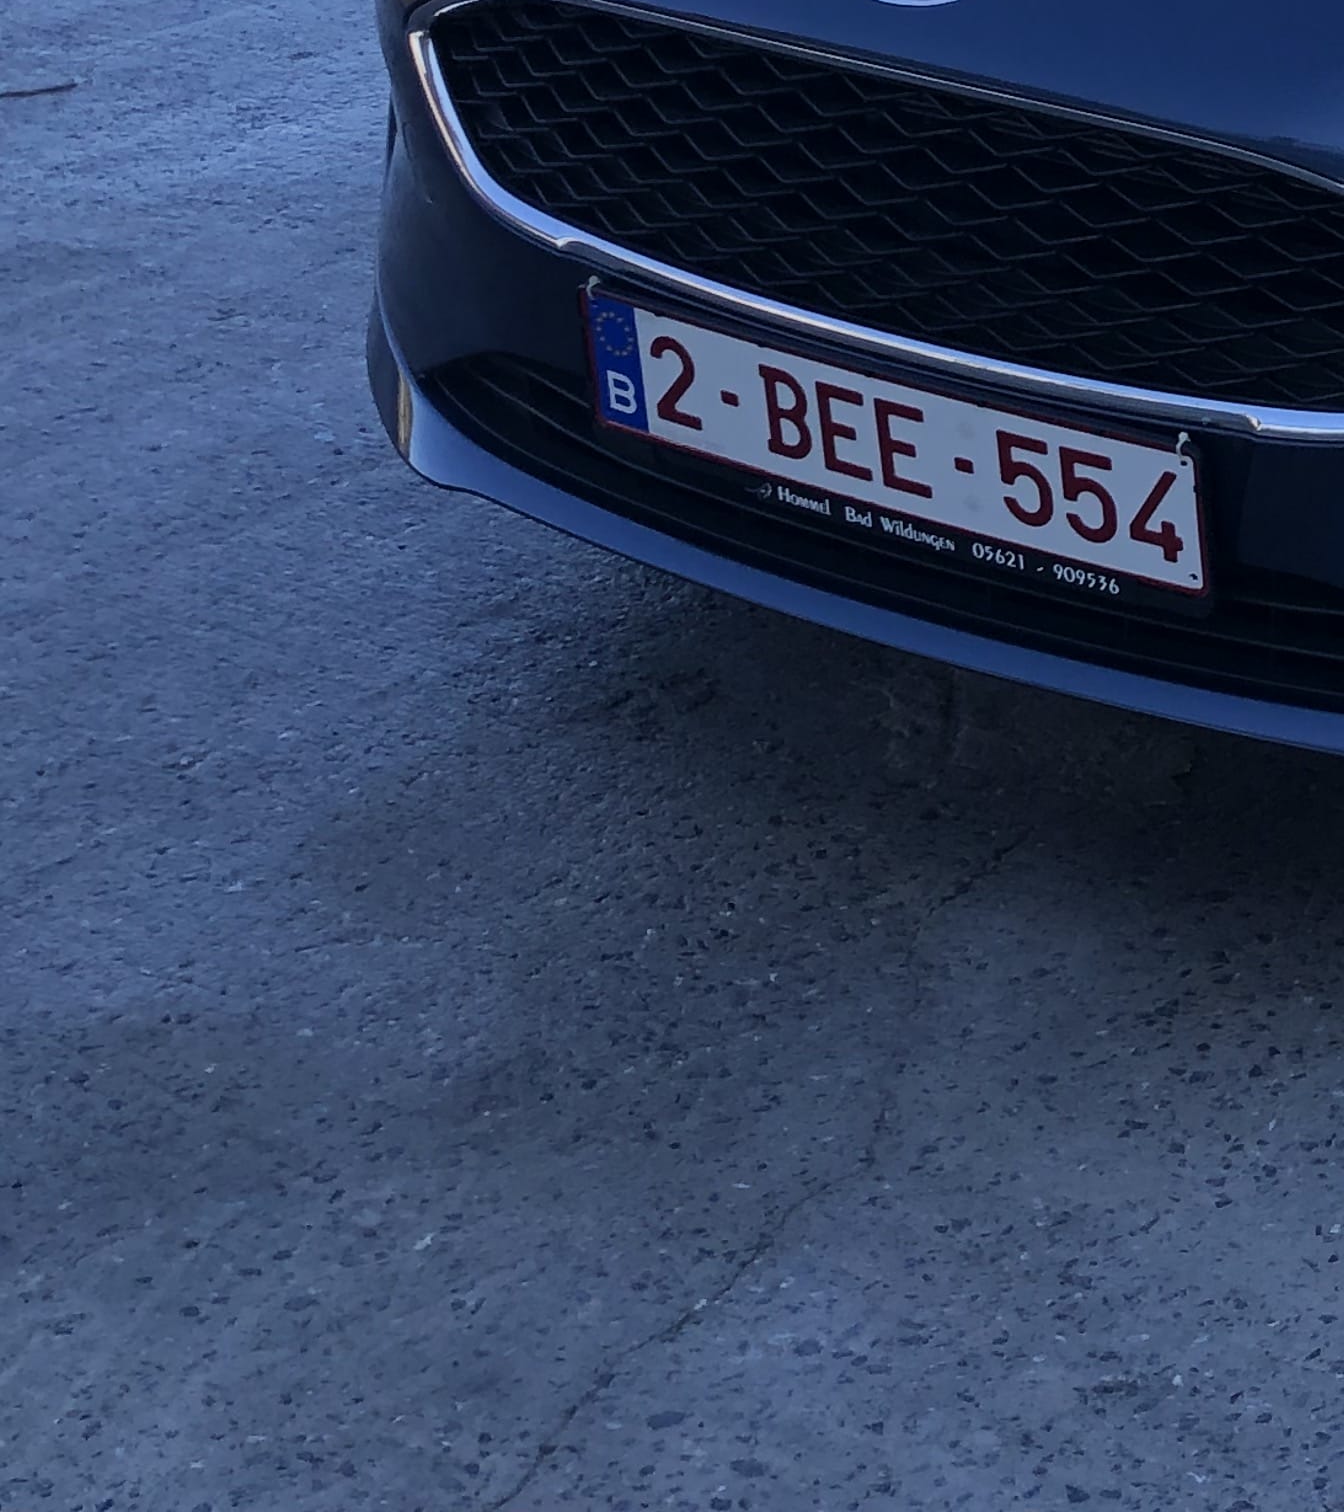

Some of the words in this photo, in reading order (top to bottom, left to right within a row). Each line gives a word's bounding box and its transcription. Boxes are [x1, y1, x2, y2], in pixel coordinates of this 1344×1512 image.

[606, 369, 638, 414] B
[650, 335, 1184, 563] 2-BEE-554
[845, 506, 873, 528] Bad
[972, 542, 1025, 570] 05621
[1052, 563, 1120, 595] 909536
